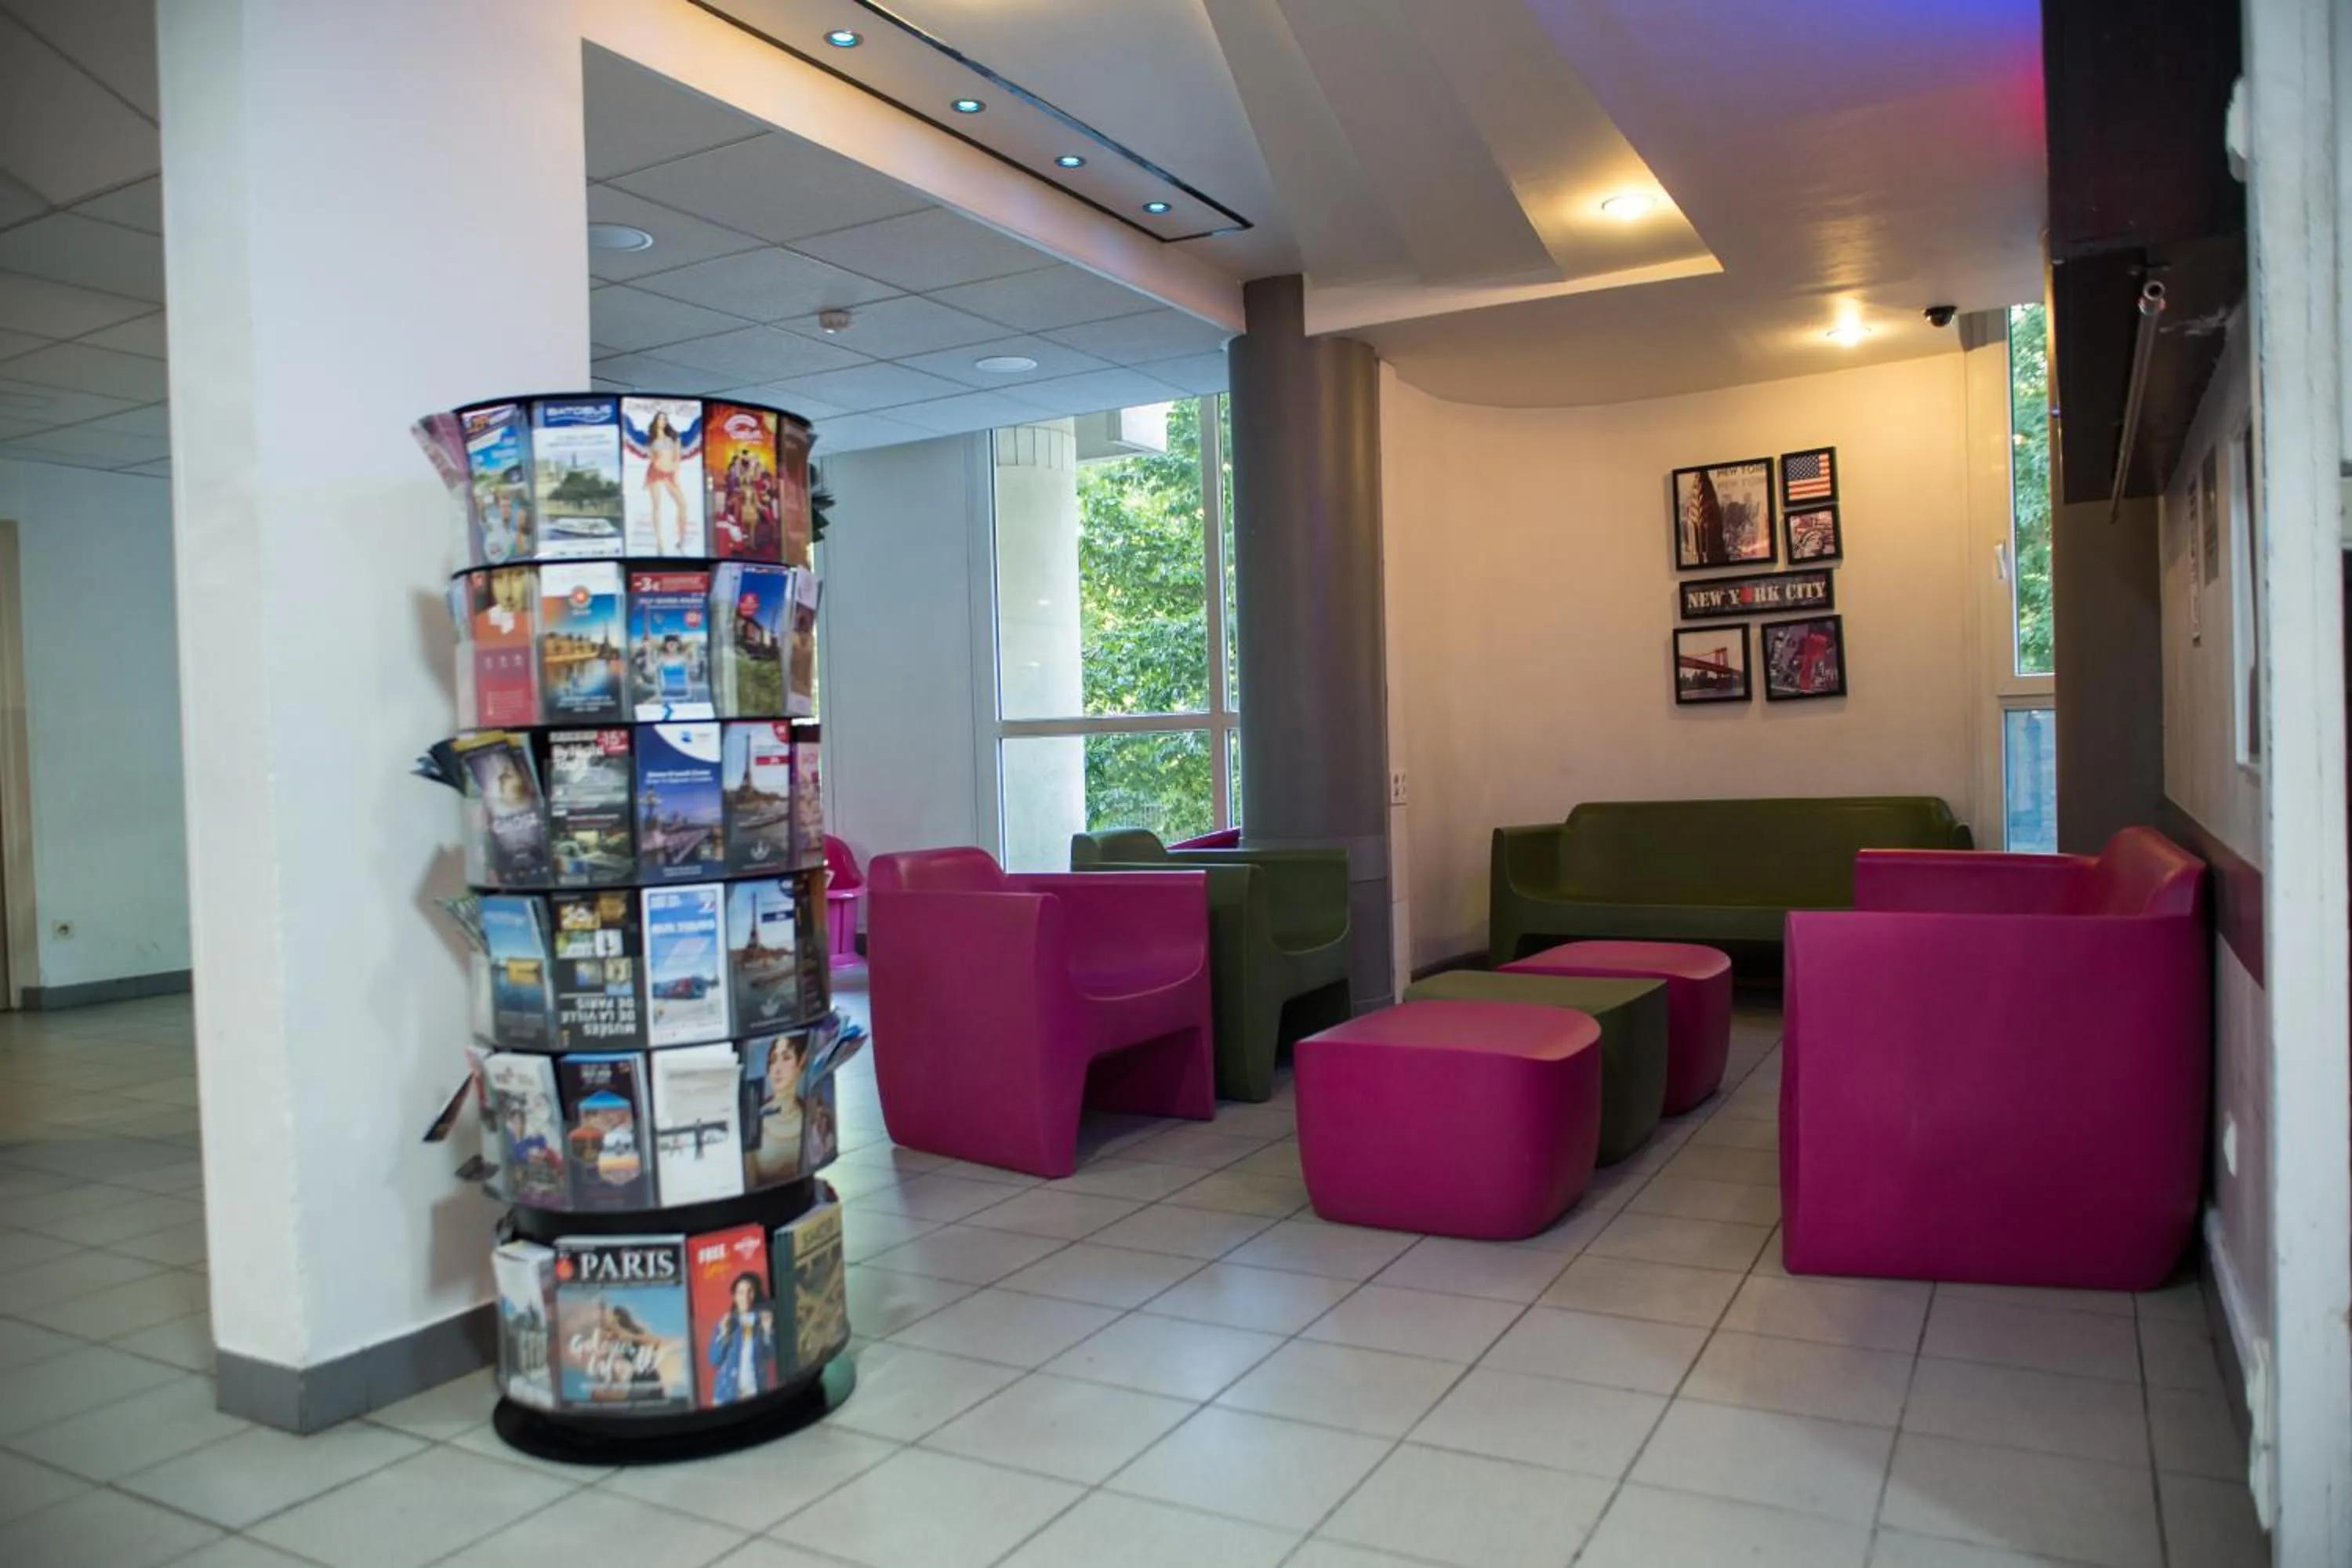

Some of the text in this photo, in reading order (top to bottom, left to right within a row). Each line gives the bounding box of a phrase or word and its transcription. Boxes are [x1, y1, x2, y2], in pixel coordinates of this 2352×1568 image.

[1688, 590, 1725, 609] NEW
[1786, 581, 1827, 600] CITY
[579, 1250, 675, 1280] PARIS
